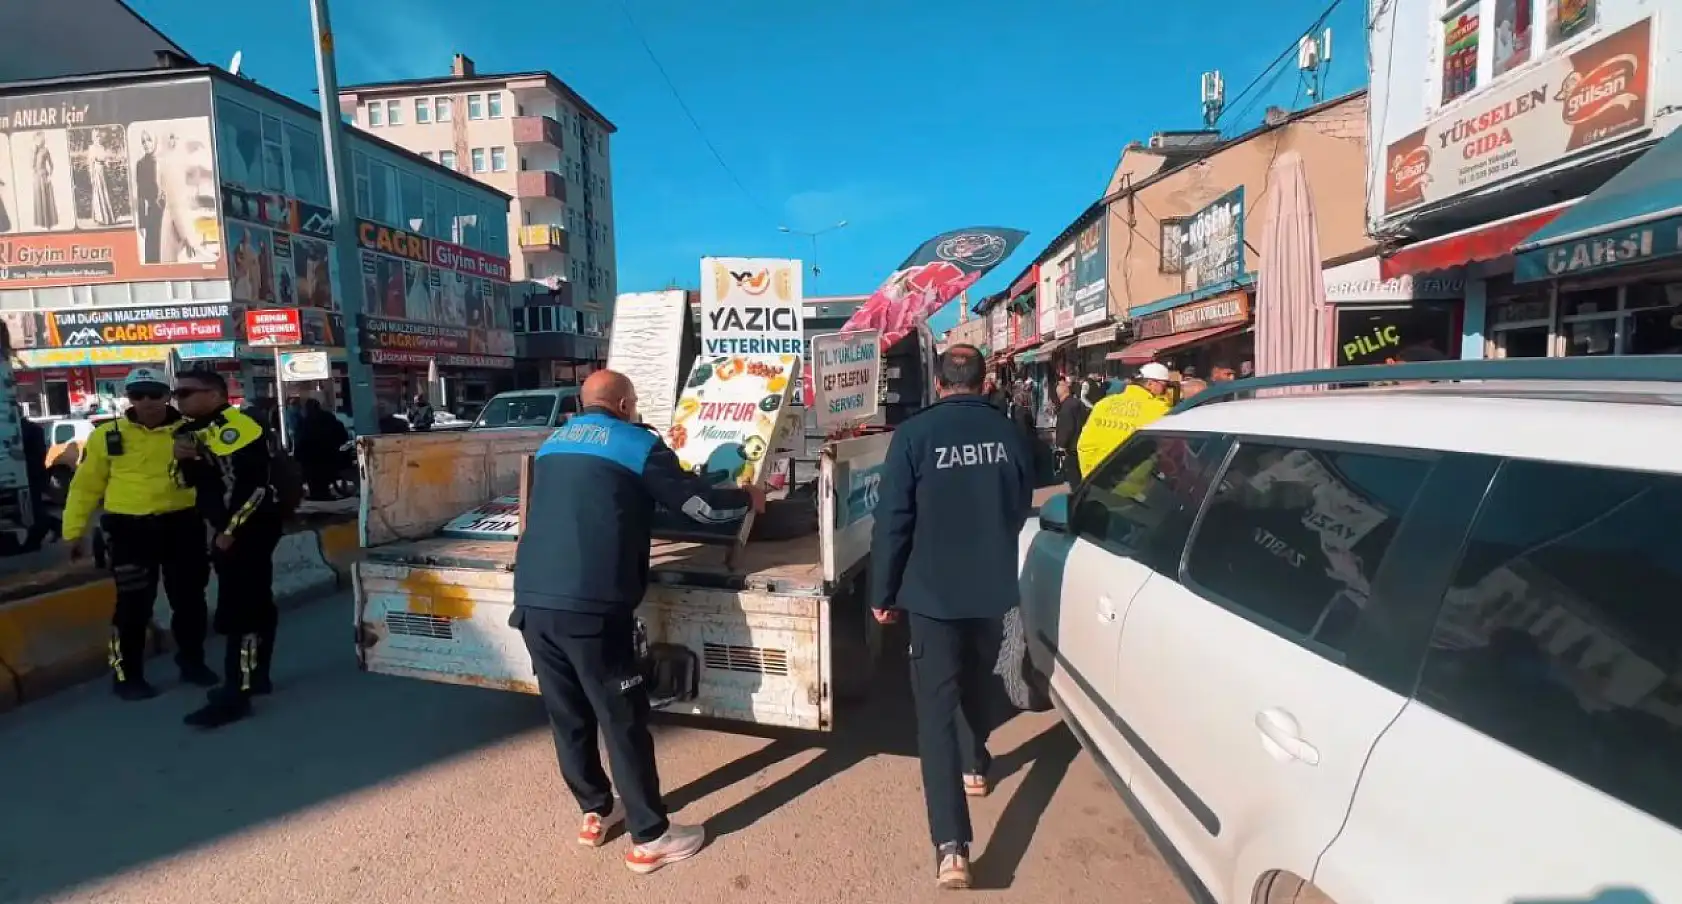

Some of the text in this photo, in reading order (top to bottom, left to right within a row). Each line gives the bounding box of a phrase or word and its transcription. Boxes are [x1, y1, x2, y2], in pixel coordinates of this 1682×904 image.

[1568, 76, 1626, 115] gülsan
[13, 107, 57, 128] ANLAR
[1439, 84, 1549, 148] YÜKSELEN
[1462, 127, 1513, 160] GIDA
[17, 244, 65, 265] Giyim
[435, 244, 477, 271] Giyim
[181, 304, 229, 319] BULUNUR
[709, 306, 797, 332] YAZICI
[153, 322, 188, 339] Giyim
[705, 334, 801, 354] VETERİNER
[698, 401, 757, 422] TAYFUR
[935, 442, 1008, 469] ZABITA
